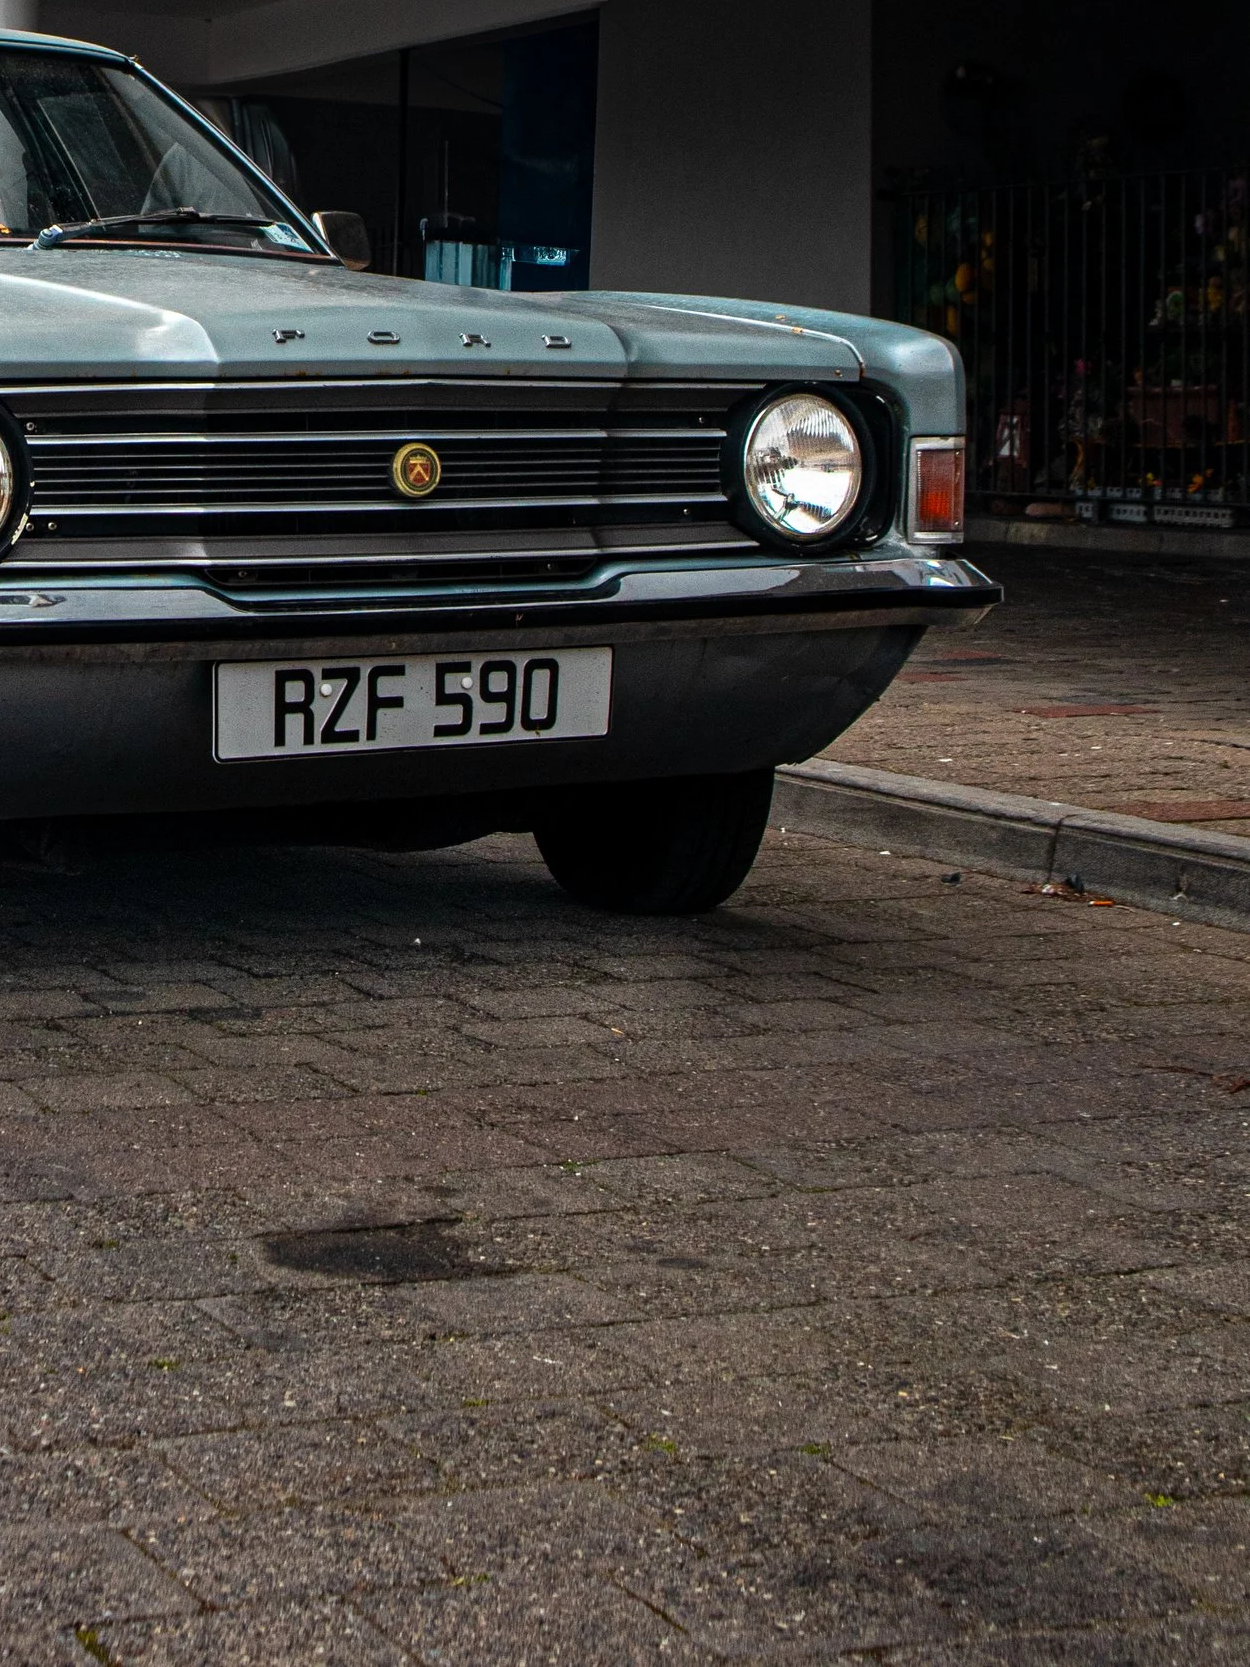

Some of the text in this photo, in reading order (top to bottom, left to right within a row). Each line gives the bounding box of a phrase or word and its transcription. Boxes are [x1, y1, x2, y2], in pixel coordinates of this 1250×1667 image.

[271, 327, 573, 349] FORD
[274, 658, 560, 747] RZF 590
